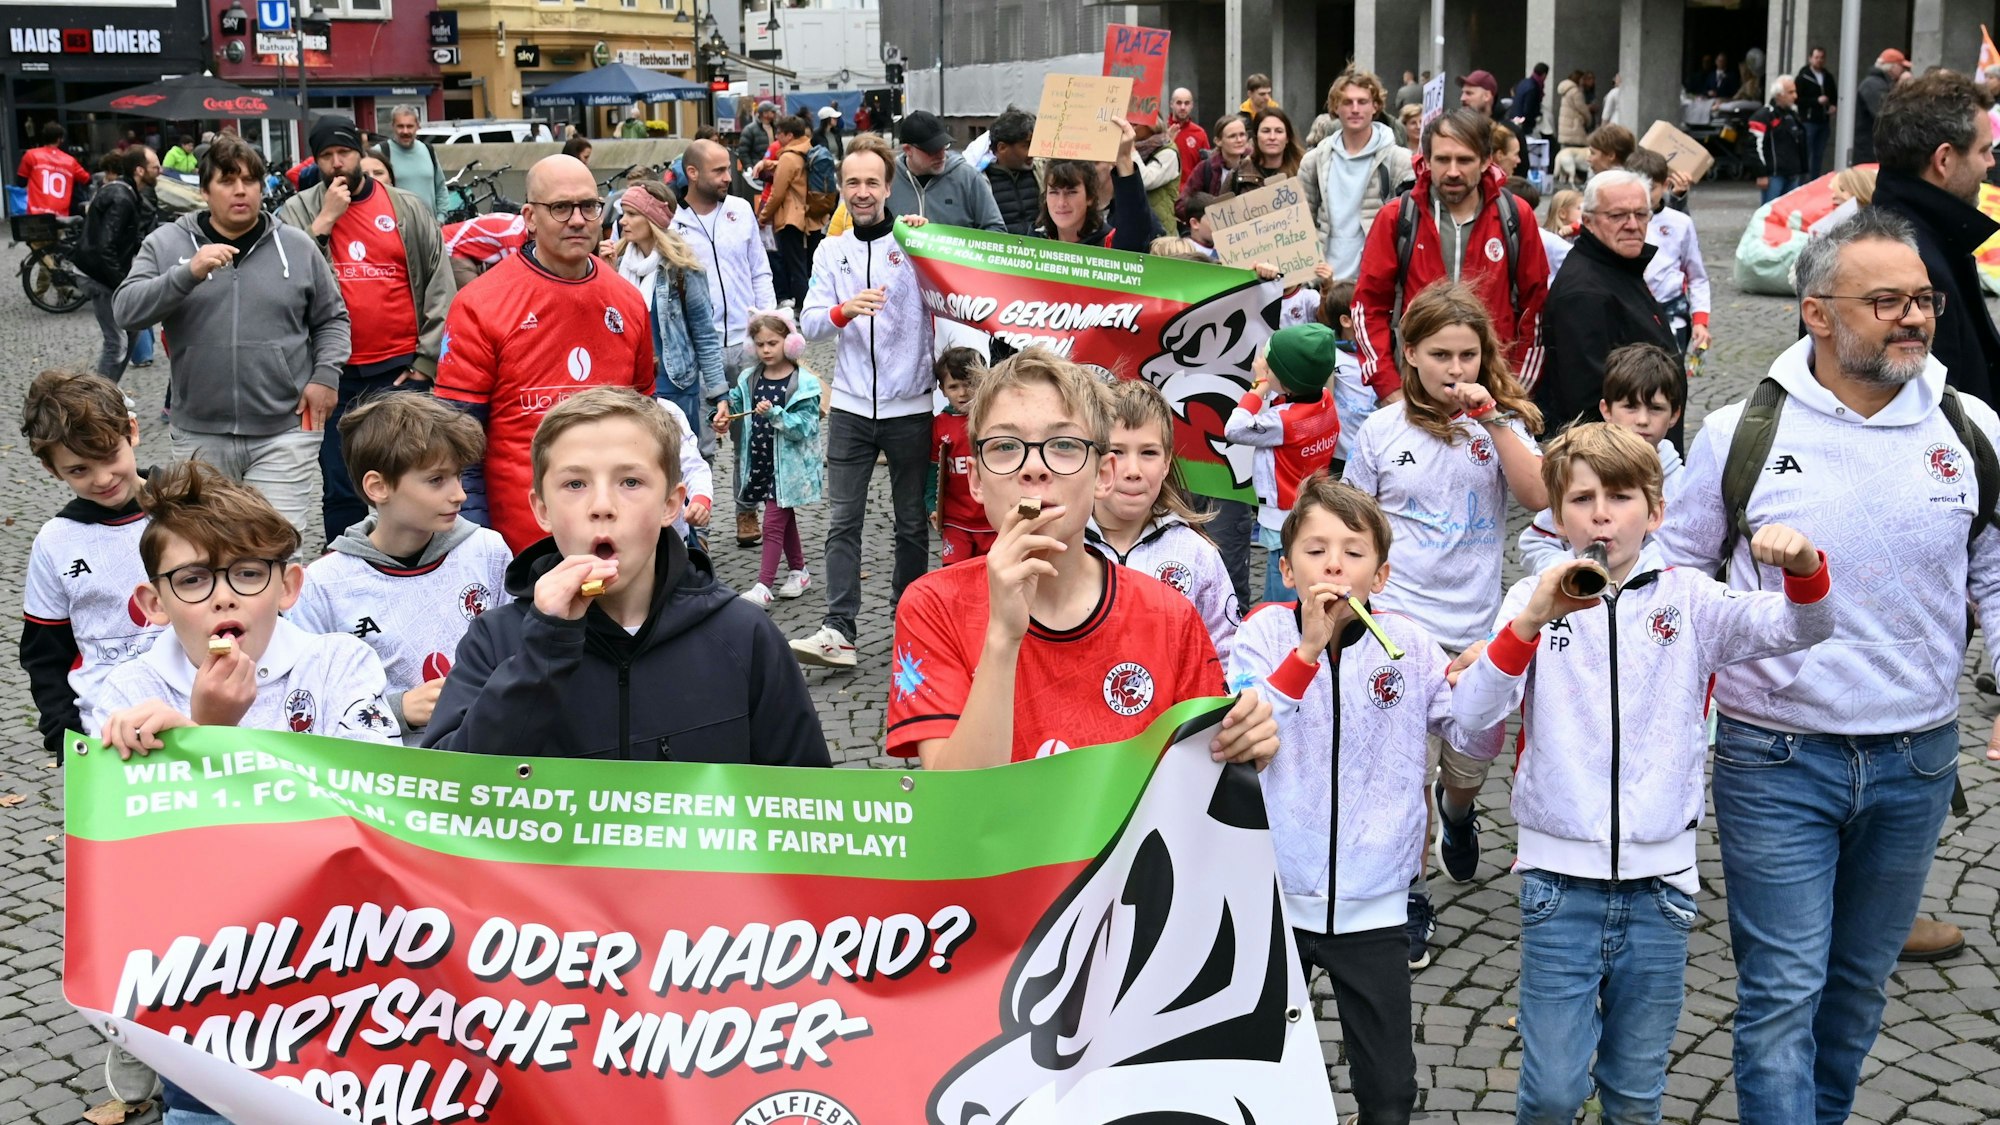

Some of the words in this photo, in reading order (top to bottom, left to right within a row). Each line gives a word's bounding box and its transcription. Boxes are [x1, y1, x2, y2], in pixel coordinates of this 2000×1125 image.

[261, 2, 286, 28] U
[10, 28, 62, 53] HAUS
[92, 25, 161, 53] DÖNERS
[259, 44, 294, 52] Rathaus
[1115, 28, 1169, 56] PLATZ
[517, 50, 535, 63] sky
[639, 54, 671, 66] Rathaus
[672, 53, 690, 66] Treff
[42, 169, 67, 199] 10
[1211, 205, 1239, 230] Mit
[1242, 197, 1269, 221] dem
[931, 235, 966, 247] LIEBEN
[968, 240, 1004, 253] UNSERE
[1006, 245, 1037, 260] STADT,
[1039, 250, 1083, 264] UNSEREN
[1085, 256, 1121, 272] VEREIN
[1124, 262, 1144, 274] UND
[1220, 250, 1240, 265] Wir
[1274, 230, 1308, 248] Plätze
[361, 265, 397, 277] Tom?
[905, 238, 923, 249] DEN
[939, 245, 951, 254] FC
[987, 255, 1033, 270] GENAUSO
[1035, 262, 1069, 275] LIEBEN
[1071, 267, 1090, 279] WIR
[1092, 270, 1142, 287] FAIRPLAY!
[921, 287, 948, 313] WIR
[947, 293, 998, 323] SIND
[997, 300, 1144, 334] GEKOMMEN,
[520, 394, 552, 410] Wo
[1931, 471, 1961, 483] COLONIA
[1550, 636, 1570, 652] FP
[1107, 664, 1150, 682] BALLFIEBER
[1370, 668, 1402, 682] BALLFIEBER
[1109, 700, 1148, 714] COLONIA
[1374, 697, 1400, 708] COLONIA
[124, 761, 191, 785] WIR
[201, 751, 318, 782] LIEBEN
[328, 768, 459, 802] UNSERE
[470, 784, 577, 816] STADT,
[588, 790, 735, 817] UNSEREN
[745, 796, 843, 821] VEREIN
[853, 801, 913, 824] UND
[125, 790, 198, 817] DEN
[211, 788, 240, 808] 1.
[254, 779, 297, 806] FC
[405, 810, 563, 844] GENAUSO
[573, 823, 687, 849] LIEBEN
[698, 827, 758, 851] WIR
[767, 829, 908, 858] FAIRPLAY!
[113, 902, 452, 1018] MAILAND
[467, 916, 638, 991] ODER
[649, 905, 973, 993] MADRID?
[168, 978, 586, 1072] AUPTSACHE
[593, 998, 870, 1075] KINDER-
